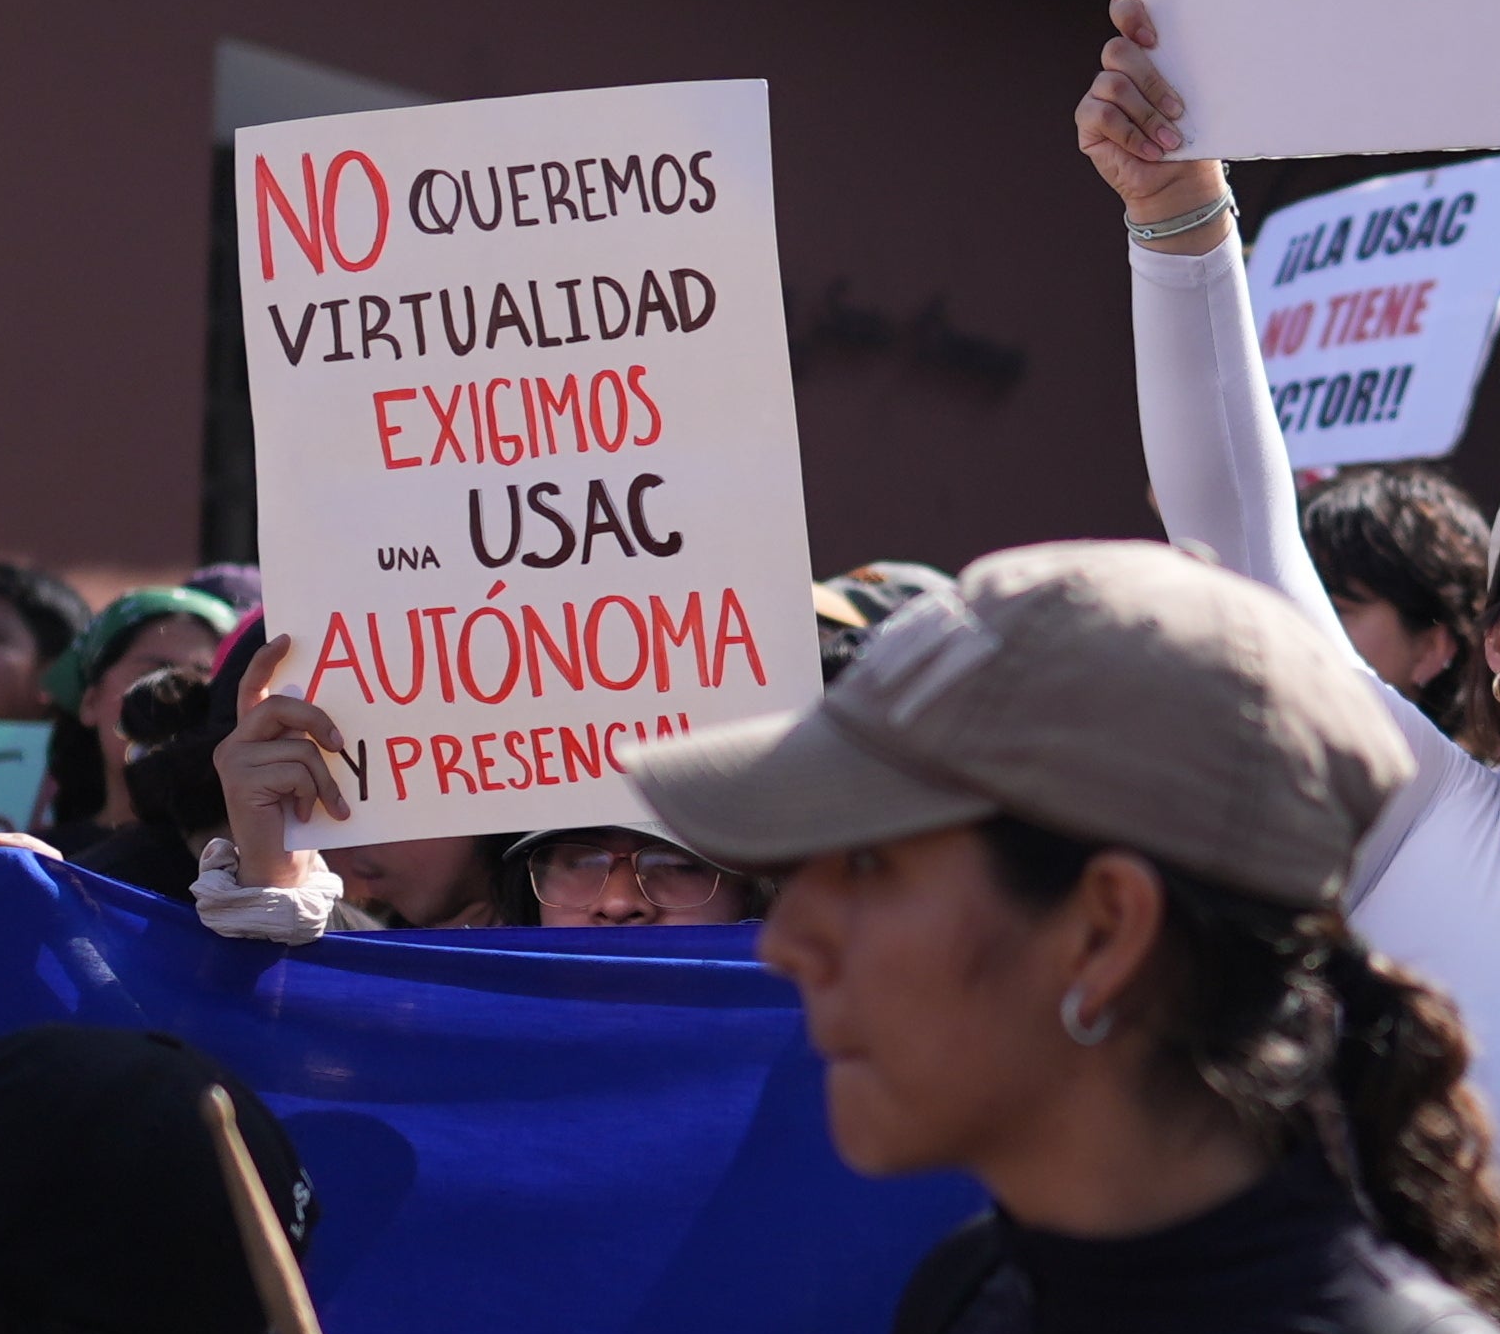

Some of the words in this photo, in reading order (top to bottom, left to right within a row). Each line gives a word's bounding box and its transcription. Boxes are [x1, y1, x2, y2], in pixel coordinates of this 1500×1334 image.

[255, 150, 391, 281] NO
[408, 150, 717, 235] QUEREMOS
[1356, 192, 1476, 261] USAC
[267, 267, 717, 367] VIRTUALIDAD
[1260, 301, 1315, 359] NO
[1318, 279, 1436, 349] TIENE
[372, 364, 664, 471] EXIGIMOS
[377, 545, 441, 572] UNA
[468, 472, 684, 569] USAC
[304, 579, 768, 707] AUTÓNOMA
[338, 737, 368, 802] Y
